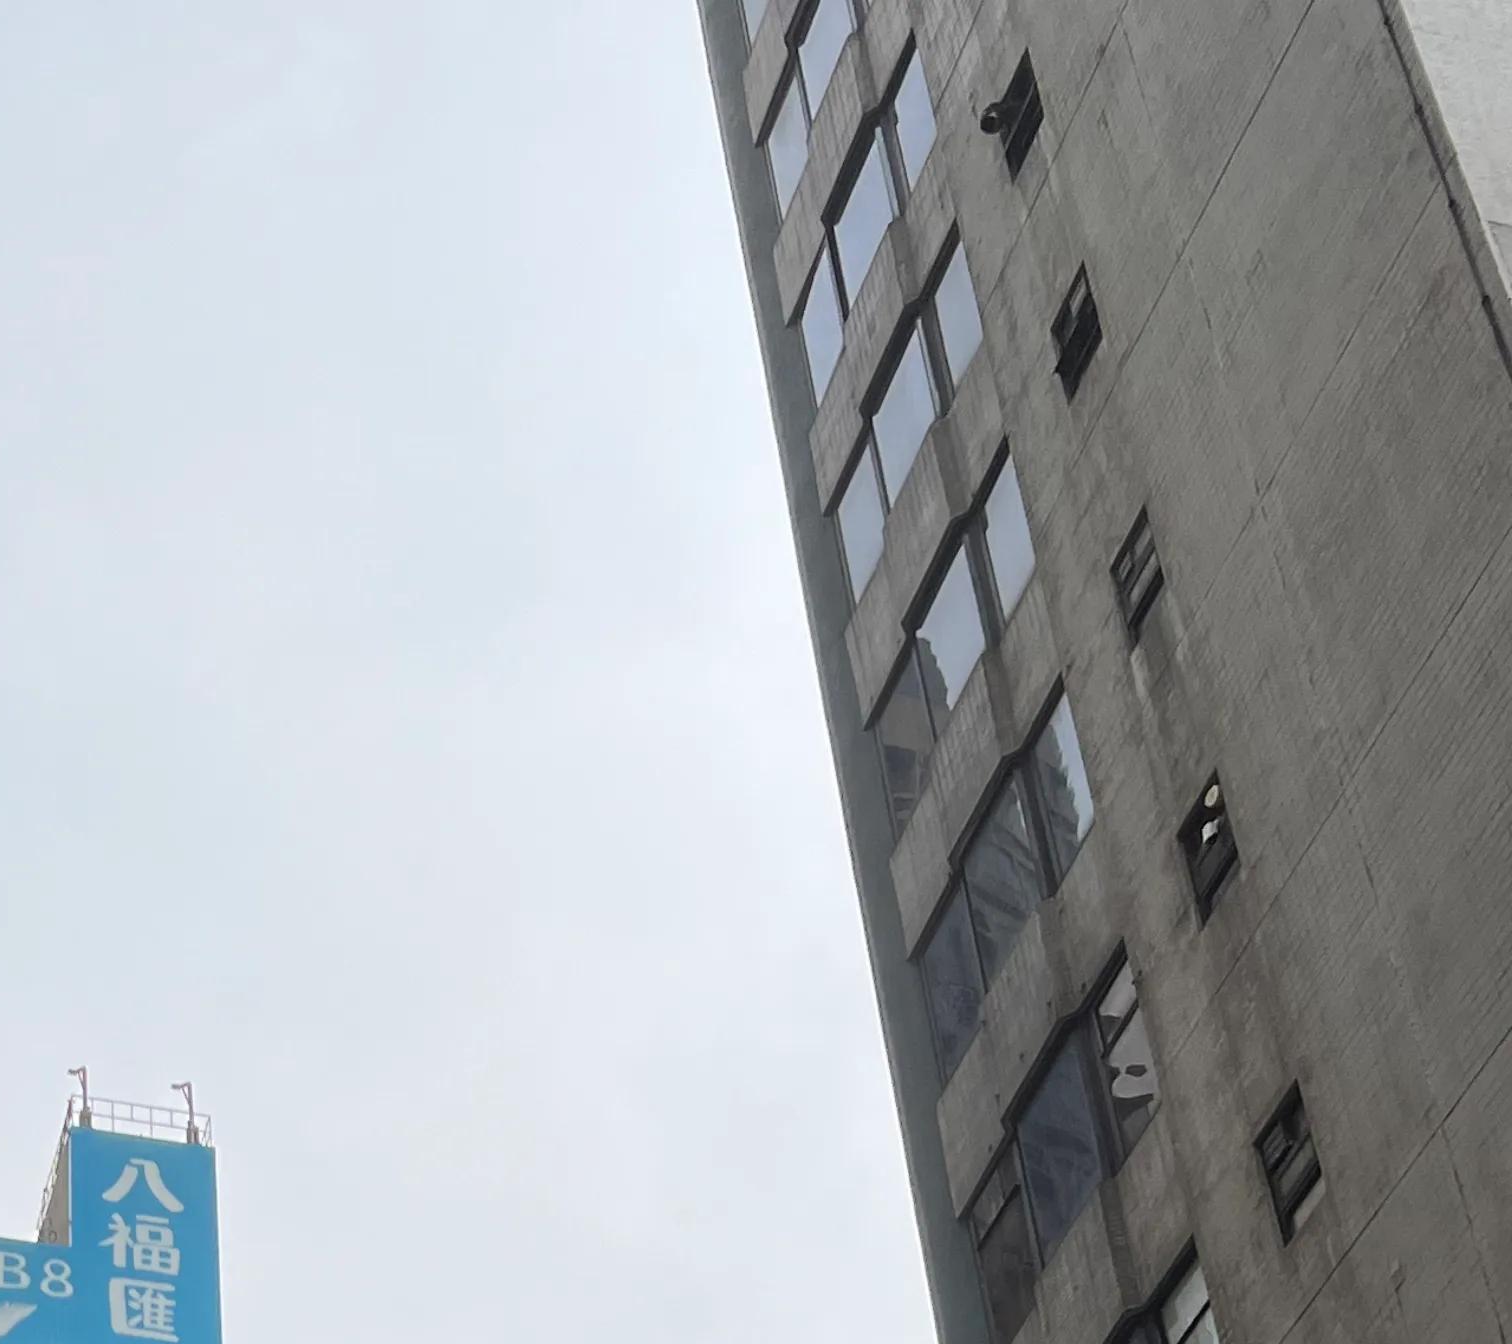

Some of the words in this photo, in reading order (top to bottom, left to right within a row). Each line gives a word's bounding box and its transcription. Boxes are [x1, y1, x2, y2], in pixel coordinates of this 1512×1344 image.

[40, 1258, 74, 1299] 8
[99, 1158, 184, 1343] 八福匯
